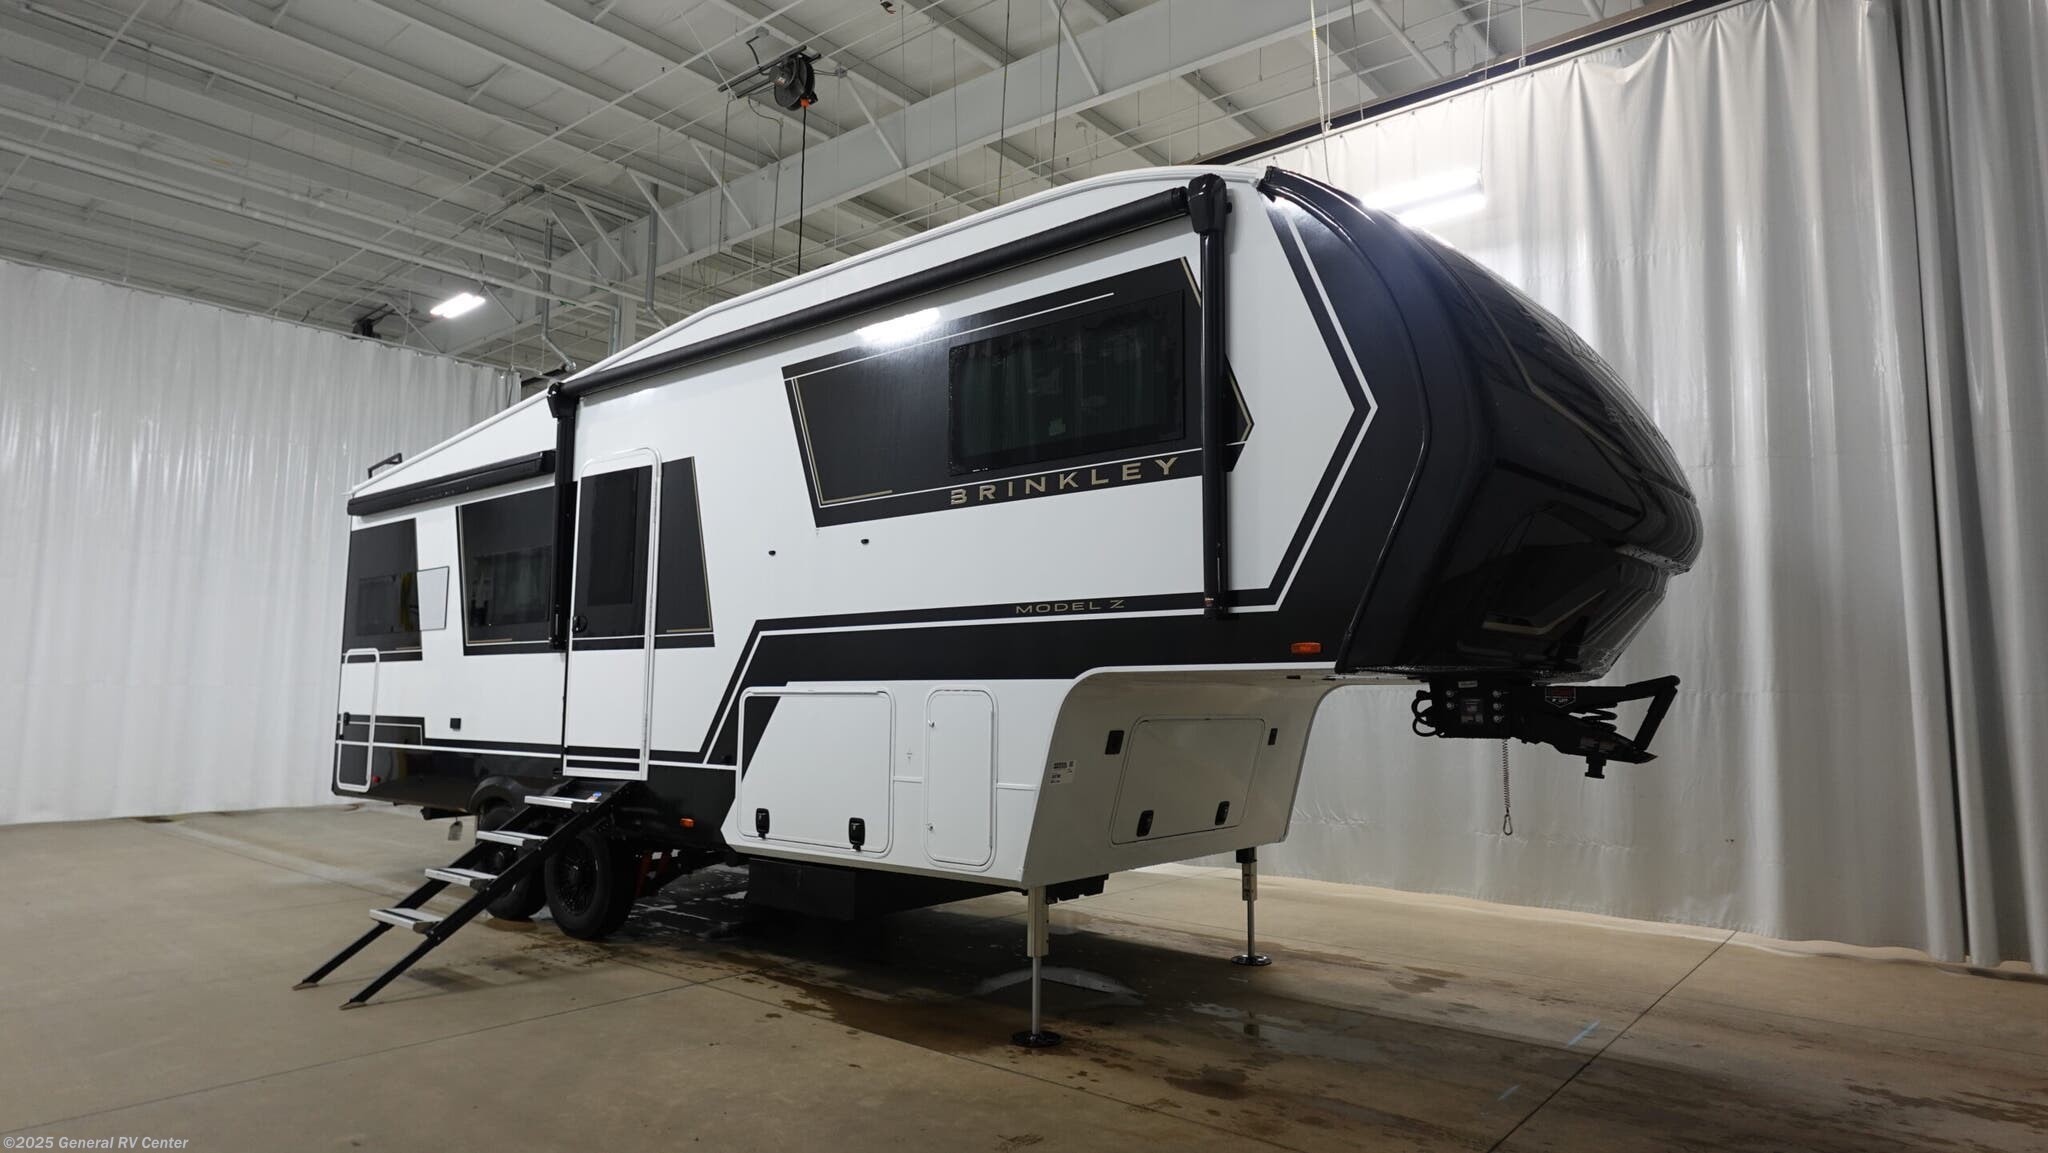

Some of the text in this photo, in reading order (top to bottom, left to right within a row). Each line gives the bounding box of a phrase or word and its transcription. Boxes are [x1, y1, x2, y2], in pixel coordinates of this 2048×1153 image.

[950, 456, 1178, 506] BRINKLEY
[1015, 599, 1125, 614] MODEL Z
